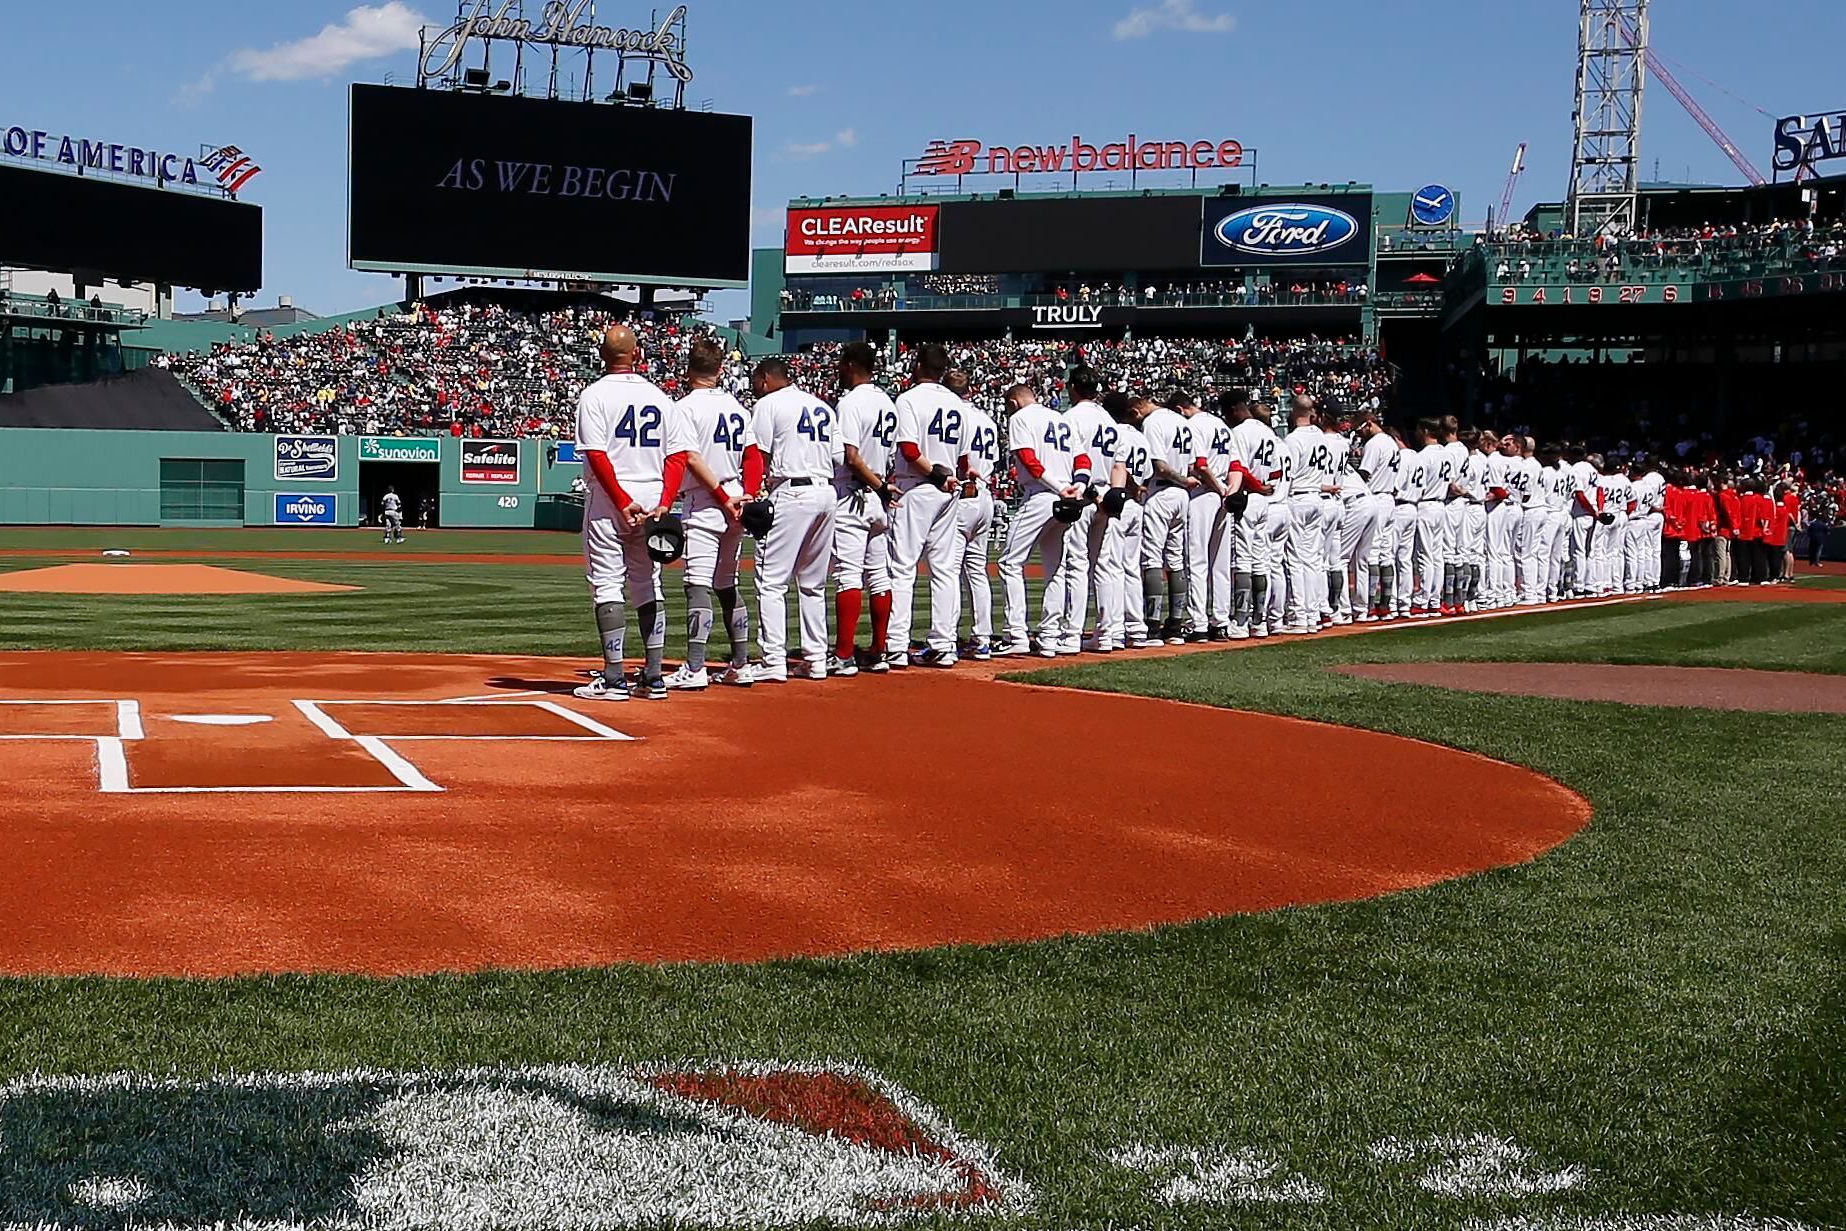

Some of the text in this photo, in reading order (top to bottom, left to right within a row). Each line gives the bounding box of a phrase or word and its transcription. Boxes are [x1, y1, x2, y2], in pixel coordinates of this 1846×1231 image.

[422, 0, 694, 82] John Hancock
[6, 126, 47, 160] OF
[56, 136, 197, 185] AMERICA
[988, 145, 1066, 174] new
[1072, 134, 1242, 172] balance
[436, 158, 677, 203] AS WE BEGIN
[801, 214, 924, 235] CLEAResult
[1242, 211, 1331, 246] Ford
[811, 259, 915, 268] clearesult.com/redsox
[1502, 286, 1517, 304] 9
[1532, 286, 1546, 304] 4
[1562, 287, 1571, 304] 1
[1618, 286, 1647, 304] 27
[1663, 285, 1678, 304] 6
[1031, 305, 1102, 323] TRULY
[614, 404, 662, 447] 42
[713, 412, 745, 451] 42
[796, 405, 831, 442] 42
[872, 409, 897, 448] 42
[927, 407, 961, 445] 42
[1043, 420, 1071, 452] 42
[378, 446, 436, 459] sunovion
[970, 425, 995, 460] 42
[1091, 423, 1118, 457] 42
[1172, 426, 1192, 454] 42
[1211, 427, 1230, 454] 42
[1254, 439, 1275, 467] 42
[463, 453, 516, 465] Safelite
[1126, 445, 1147, 477] 42
[1309, 444, 1327, 471] 42
[1439, 460, 1452, 482] 42
[1460, 457, 1470, 478] 4
[1411, 465, 1424, 488] 42
[1511, 471, 1529, 492] 42
[1554, 479, 1565, 497] 42
[286, 503, 326, 515] IRVING
[497, 496, 518, 508] 420
[1608, 488, 1622, 504] 42
[1641, 492, 1654, 507] 42
[733, 617, 749, 629] 42
[606, 638, 621, 652] 42
